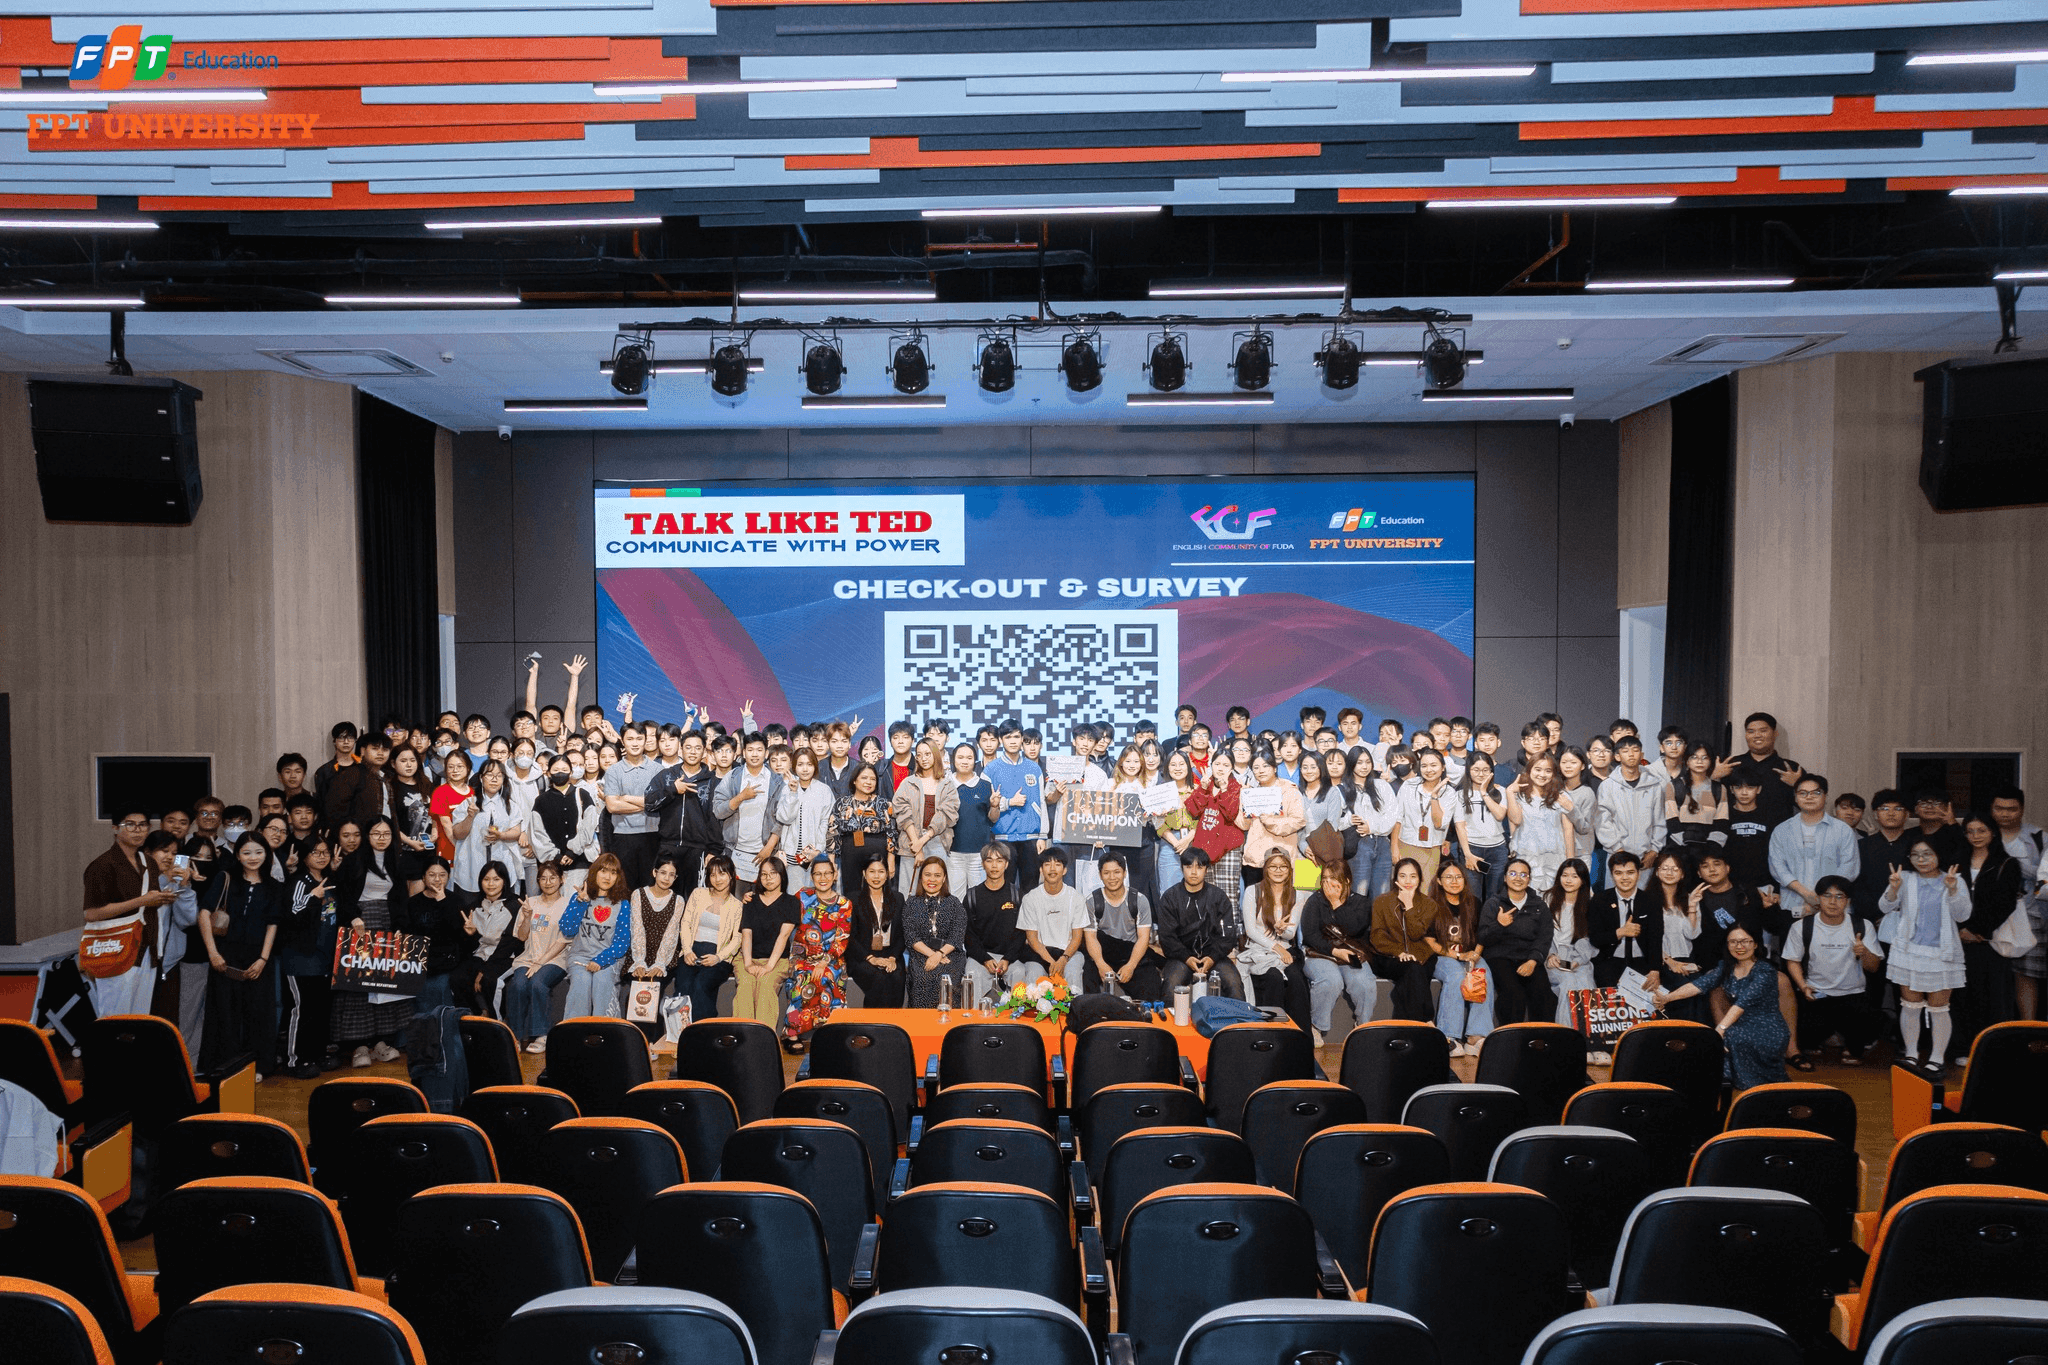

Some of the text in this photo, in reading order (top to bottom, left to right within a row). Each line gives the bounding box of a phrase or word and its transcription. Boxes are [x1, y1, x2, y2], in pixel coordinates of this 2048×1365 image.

[623, 510, 933, 535] TALK LIKE TED
[1380, 516, 1425, 526] Education
[605, 538, 941, 554] COMMUNICATE WITH POWER
[1308, 537, 1444, 549] FPT UNIVERSITY
[833, 576, 1249, 600] CHECK-OUT & SURVEY
[1066, 811, 1139, 828] CHAMPION
[581, 922, 612, 941] NY
[340, 953, 424, 975] CHAMPION
